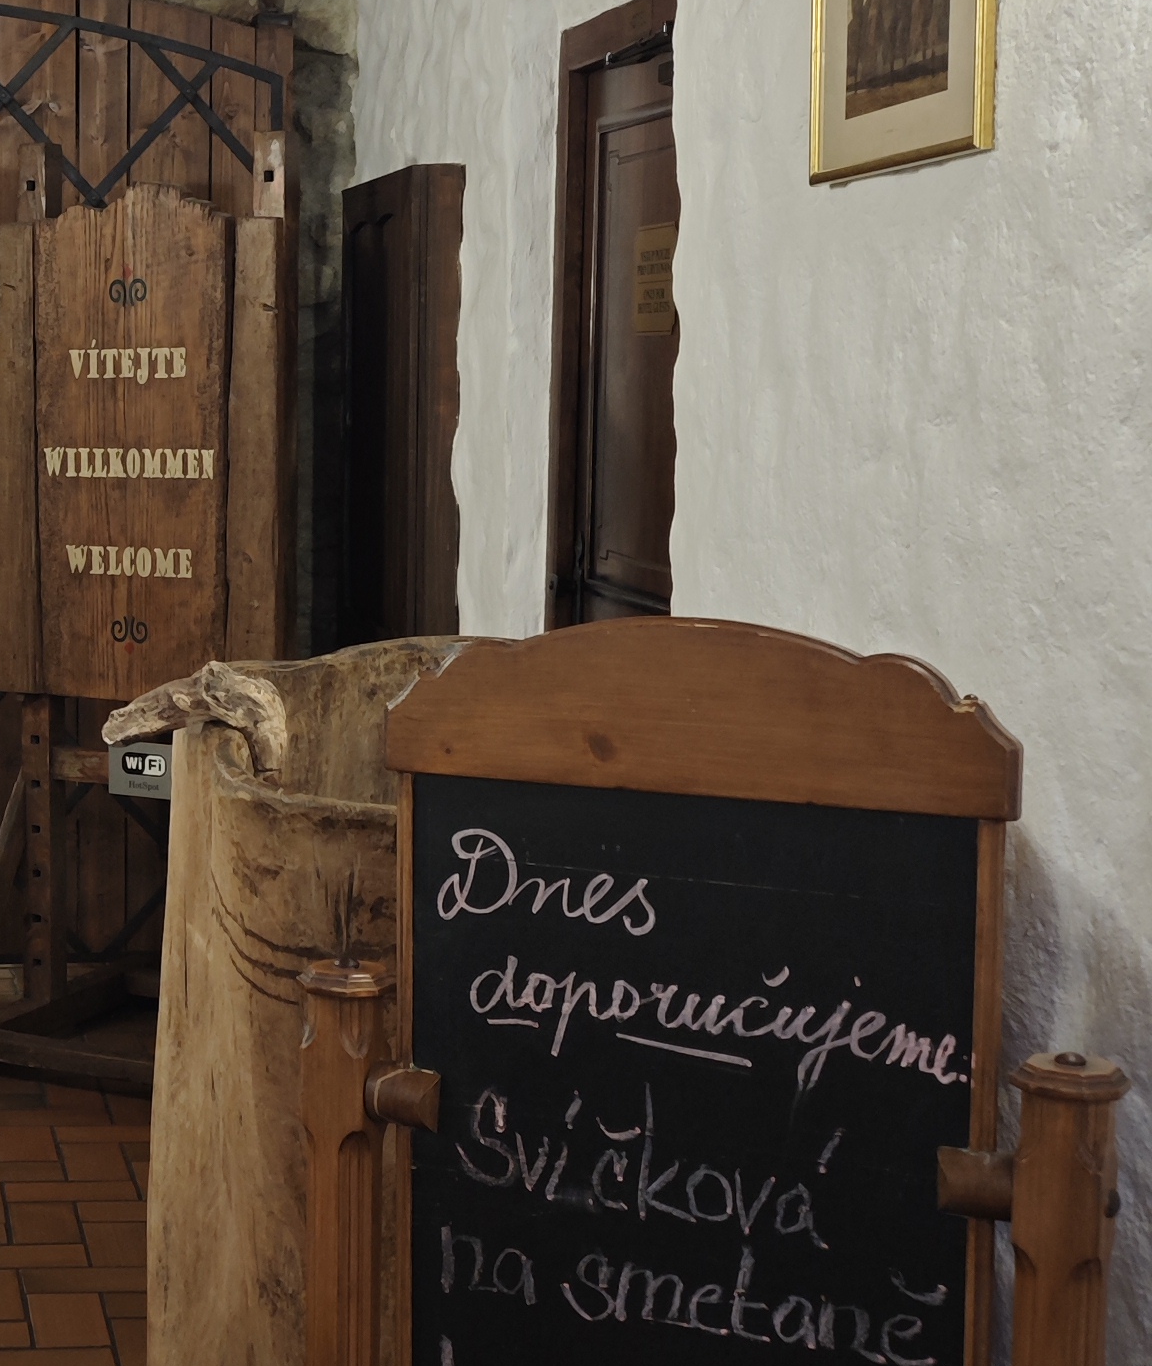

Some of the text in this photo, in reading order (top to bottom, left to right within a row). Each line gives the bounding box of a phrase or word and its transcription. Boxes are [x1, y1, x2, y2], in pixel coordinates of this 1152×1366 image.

[69, 339, 188, 385] VÍTEJTE
[43, 446, 215, 480] WILLKOMMEN
[65, 544, 193, 579] WELCOME
[128, 780, 160, 791] HotSpot
[437, 828, 657, 936] Dnes
[454, 1082, 845, 1250] Svíčková
[440, 1225, 537, 1305] na
